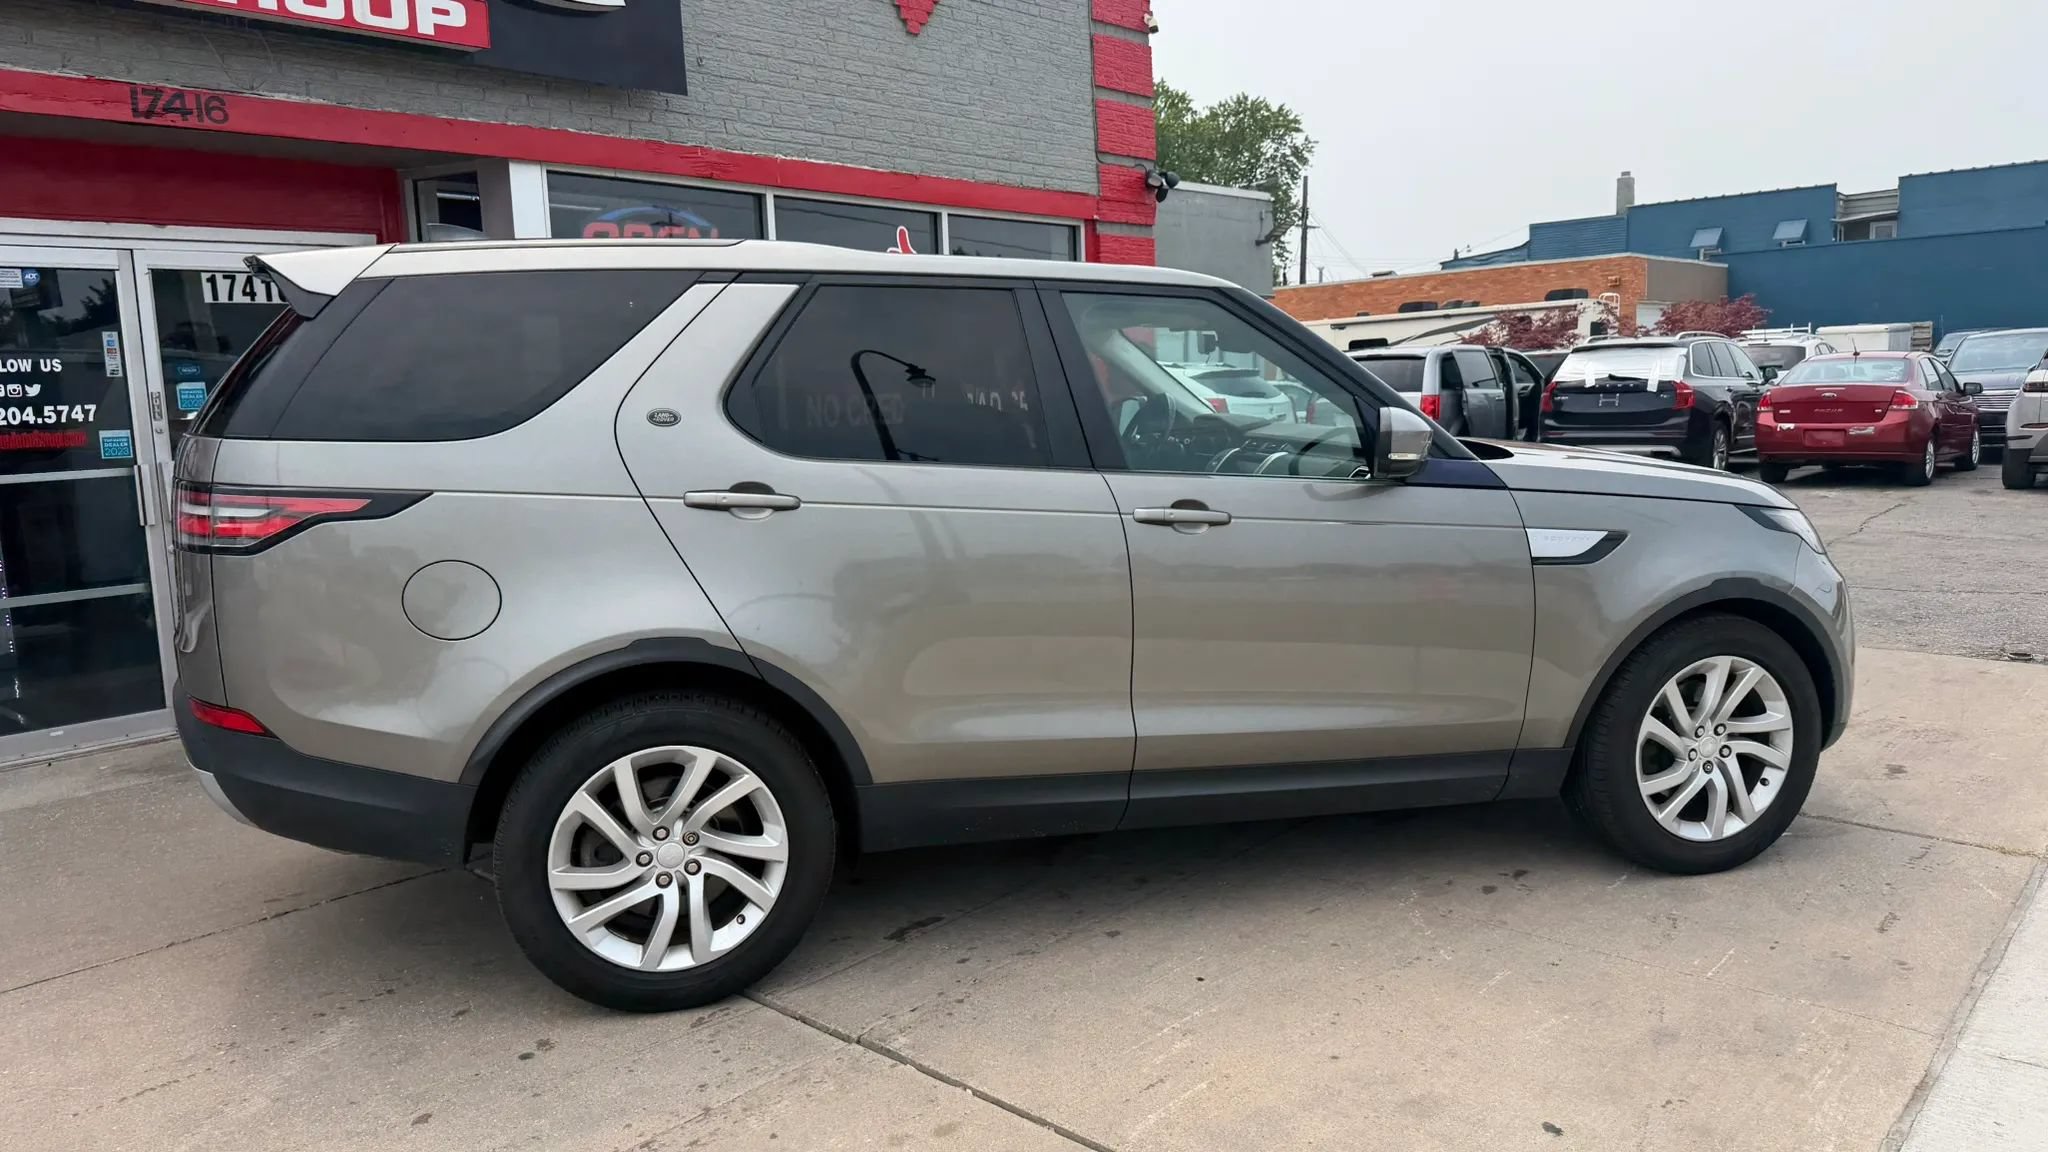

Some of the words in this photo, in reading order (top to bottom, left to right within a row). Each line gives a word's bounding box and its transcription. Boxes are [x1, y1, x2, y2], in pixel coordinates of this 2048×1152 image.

[217, 0, 467, 36] OUP
[129, 86, 229, 125] 17416
[205, 273, 287, 302] 1741
[39, 358, 63, 372] US
